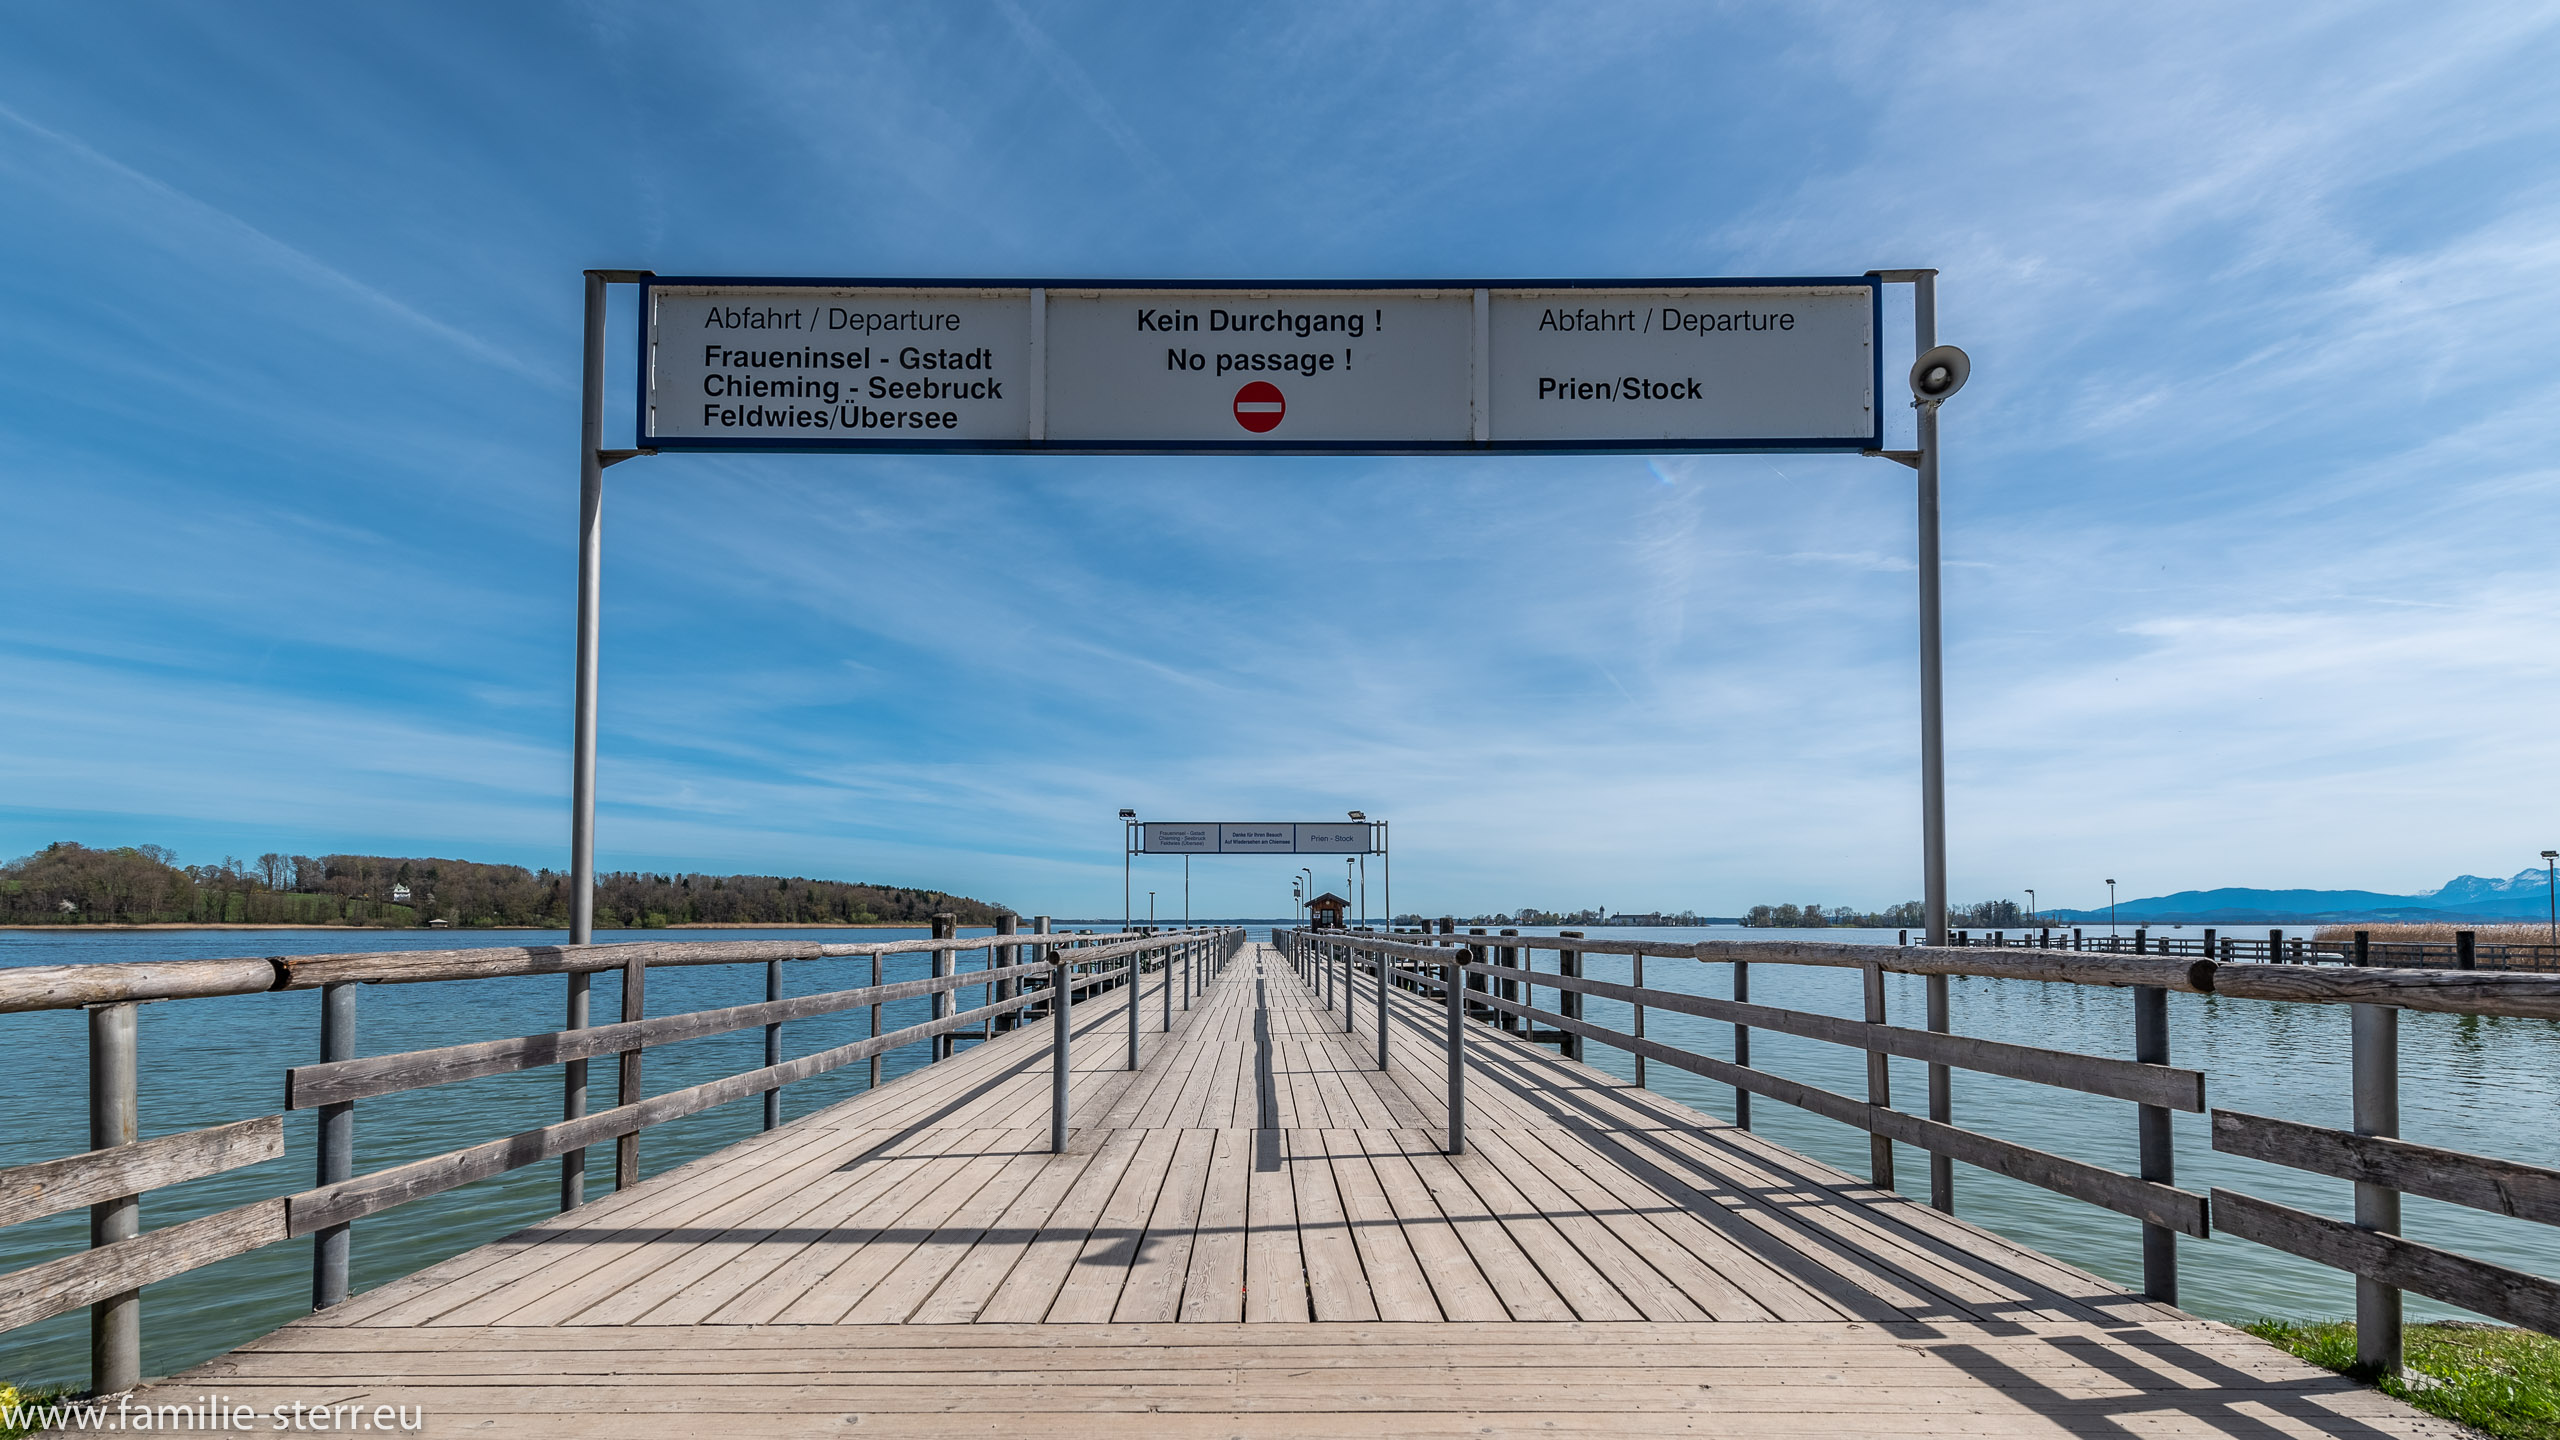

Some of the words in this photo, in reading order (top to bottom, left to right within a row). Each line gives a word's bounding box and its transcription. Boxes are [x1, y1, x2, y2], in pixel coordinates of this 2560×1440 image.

[704, 306, 802, 330] Abfahrt
[809, 307, 820, 333] /
[828, 307, 961, 337] Departure
[1137, 308, 1199, 332] Kein
[1209, 309, 1364, 338] Durchgang
[1375, 309, 1382, 332] !
[1538, 308, 1636, 332] Abfahrt
[1643, 307, 1654, 334] /
[1662, 308, 1795, 338] Departure
[704, 344, 870, 370] Fraueninsel
[899, 346, 993, 371] Gstadt
[1167, 348, 1206, 372] No
[1216, 353, 1335, 378] passage
[1345, 348, 1352, 371] !
[703, 373, 840, 404] Chieming
[868, 375, 1003, 400] Seebruck
[1538, 376, 1703, 403] Prien/Stock
[703, 399, 958, 431] Feldwies/Übersee
